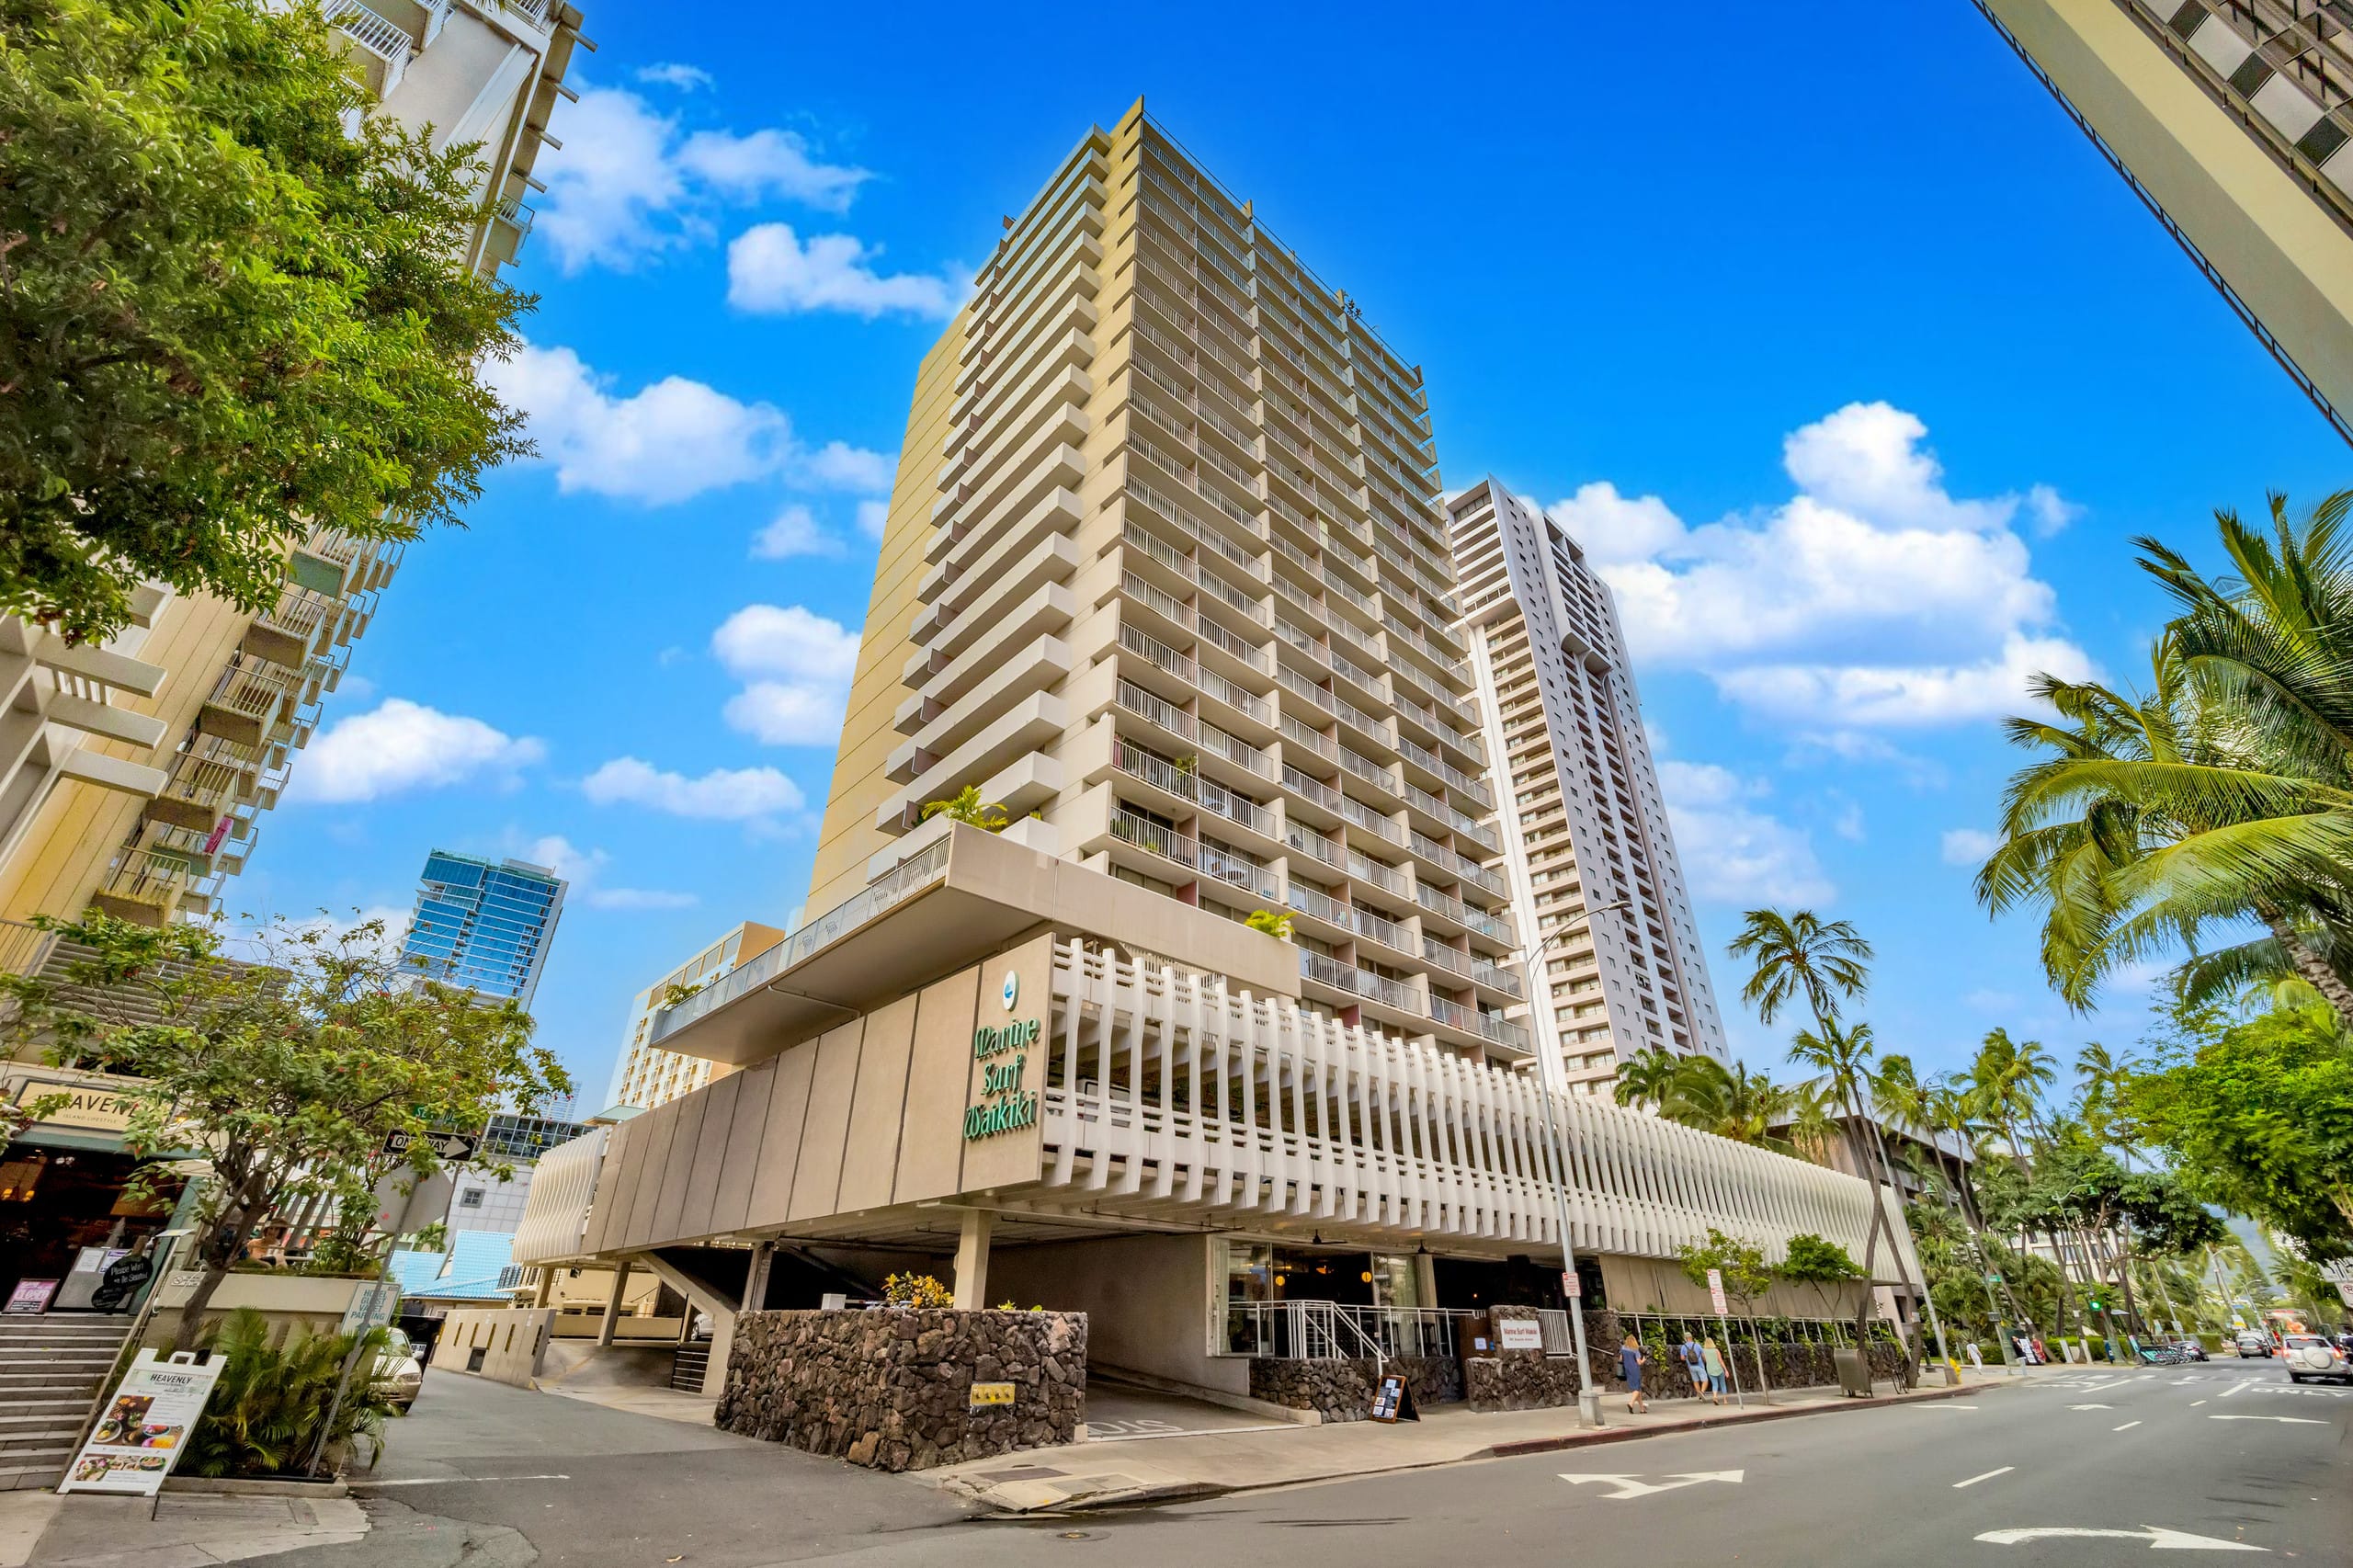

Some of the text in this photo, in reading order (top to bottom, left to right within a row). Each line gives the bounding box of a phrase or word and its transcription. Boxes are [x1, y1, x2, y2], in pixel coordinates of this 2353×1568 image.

[975, 1017, 1040, 1058] Marine
[981, 1054, 1025, 1095] Surf
[964, 1091, 1036, 1139] Waikiki
[110, 1266, 130, 1276] Please
[150, 1373, 193, 1385] HEAVENLY
